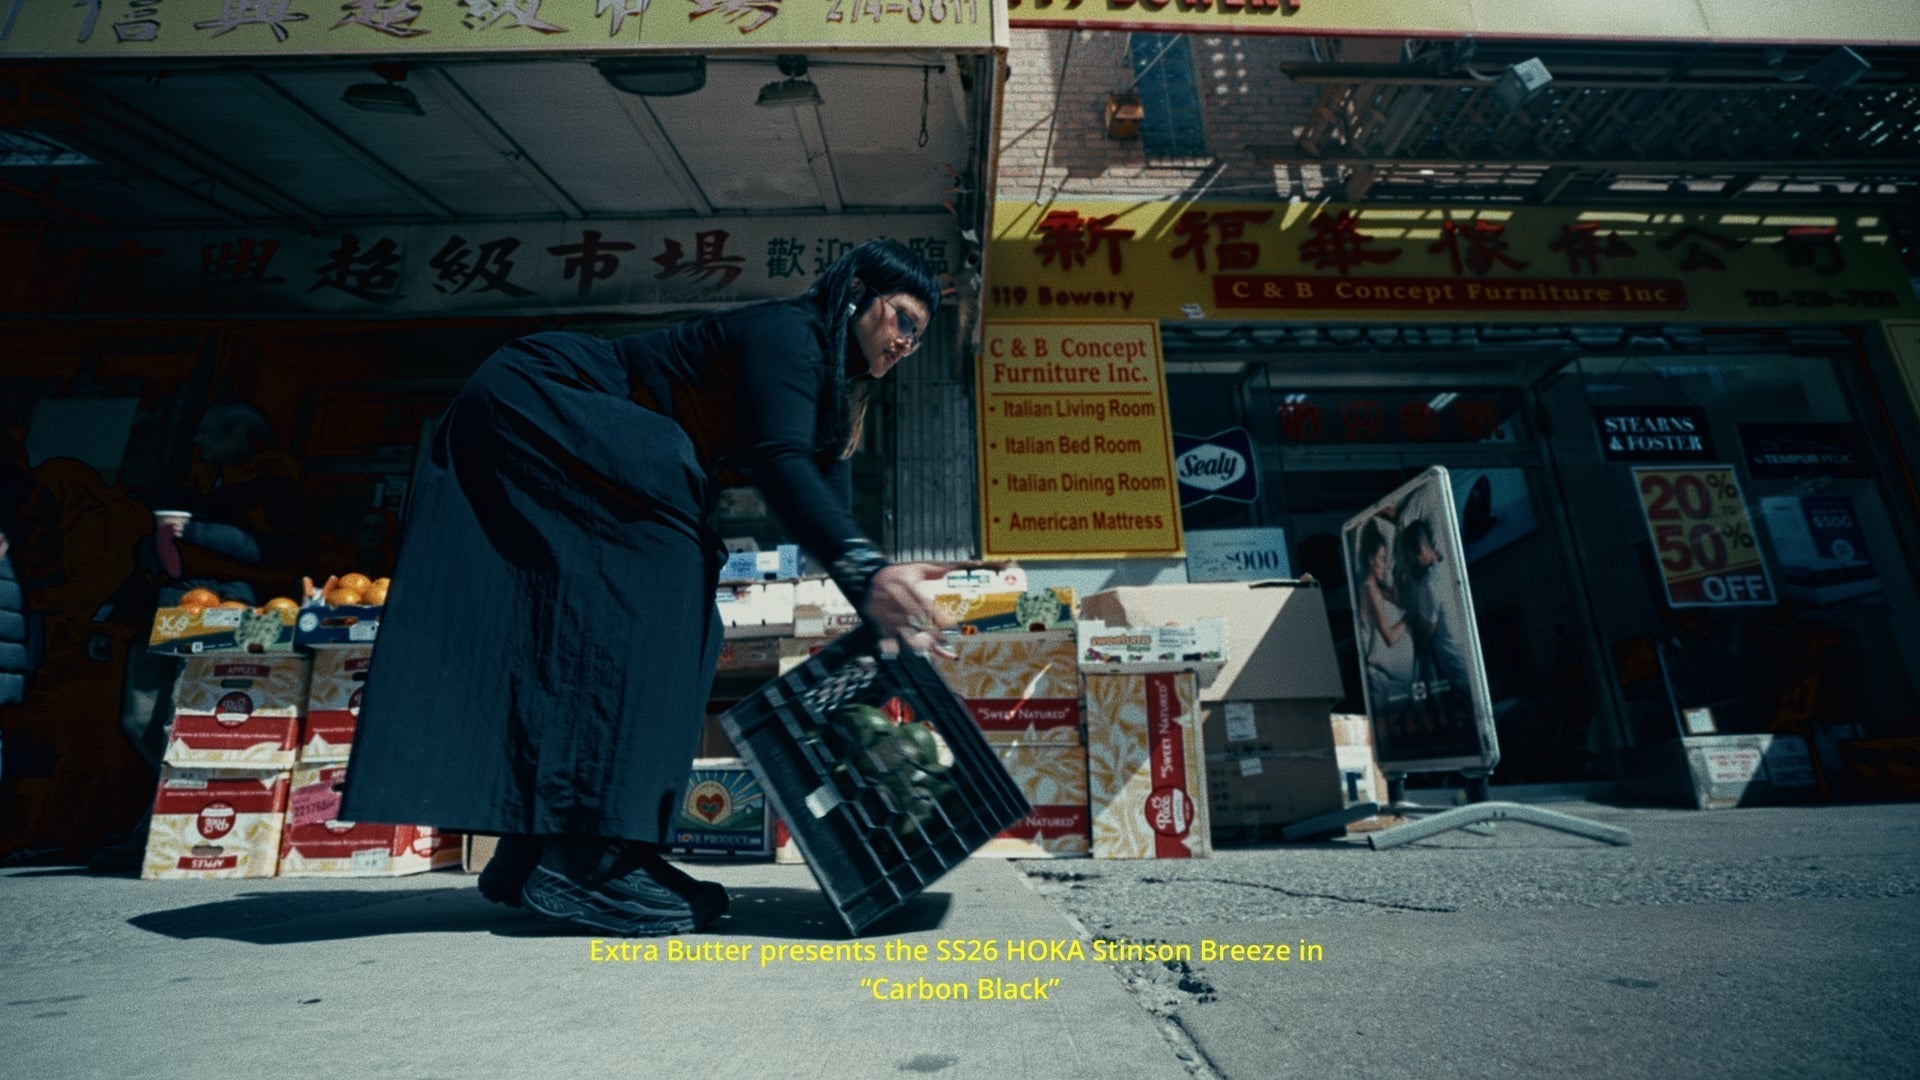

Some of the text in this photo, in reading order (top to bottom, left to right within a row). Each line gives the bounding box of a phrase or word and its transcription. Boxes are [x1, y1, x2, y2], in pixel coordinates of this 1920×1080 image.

[992, 286, 1135, 309] 119 Bowery
[1231, 281, 1668, 304] C & B Concept Furniture Inc
[990, 337, 1148, 362] C & B Concept
[993, 363, 1149, 383] Furniture Inc.
[1004, 400, 1156, 421] Italian Living Room
[1603, 416, 1696, 433] STEARNS
[1006, 436, 1142, 453] Italian Bed Room
[1608, 435, 1705, 451] & FOSTER
[1180, 452, 1238, 480] Sealy
[1007, 473, 1167, 496] Italian Dining Room
[1641, 473, 1739, 520] 20%
[1009, 512, 1163, 531] American Mattress
[1656, 522, 1754, 572] 50%
[1702, 575, 1766, 600] OFF
